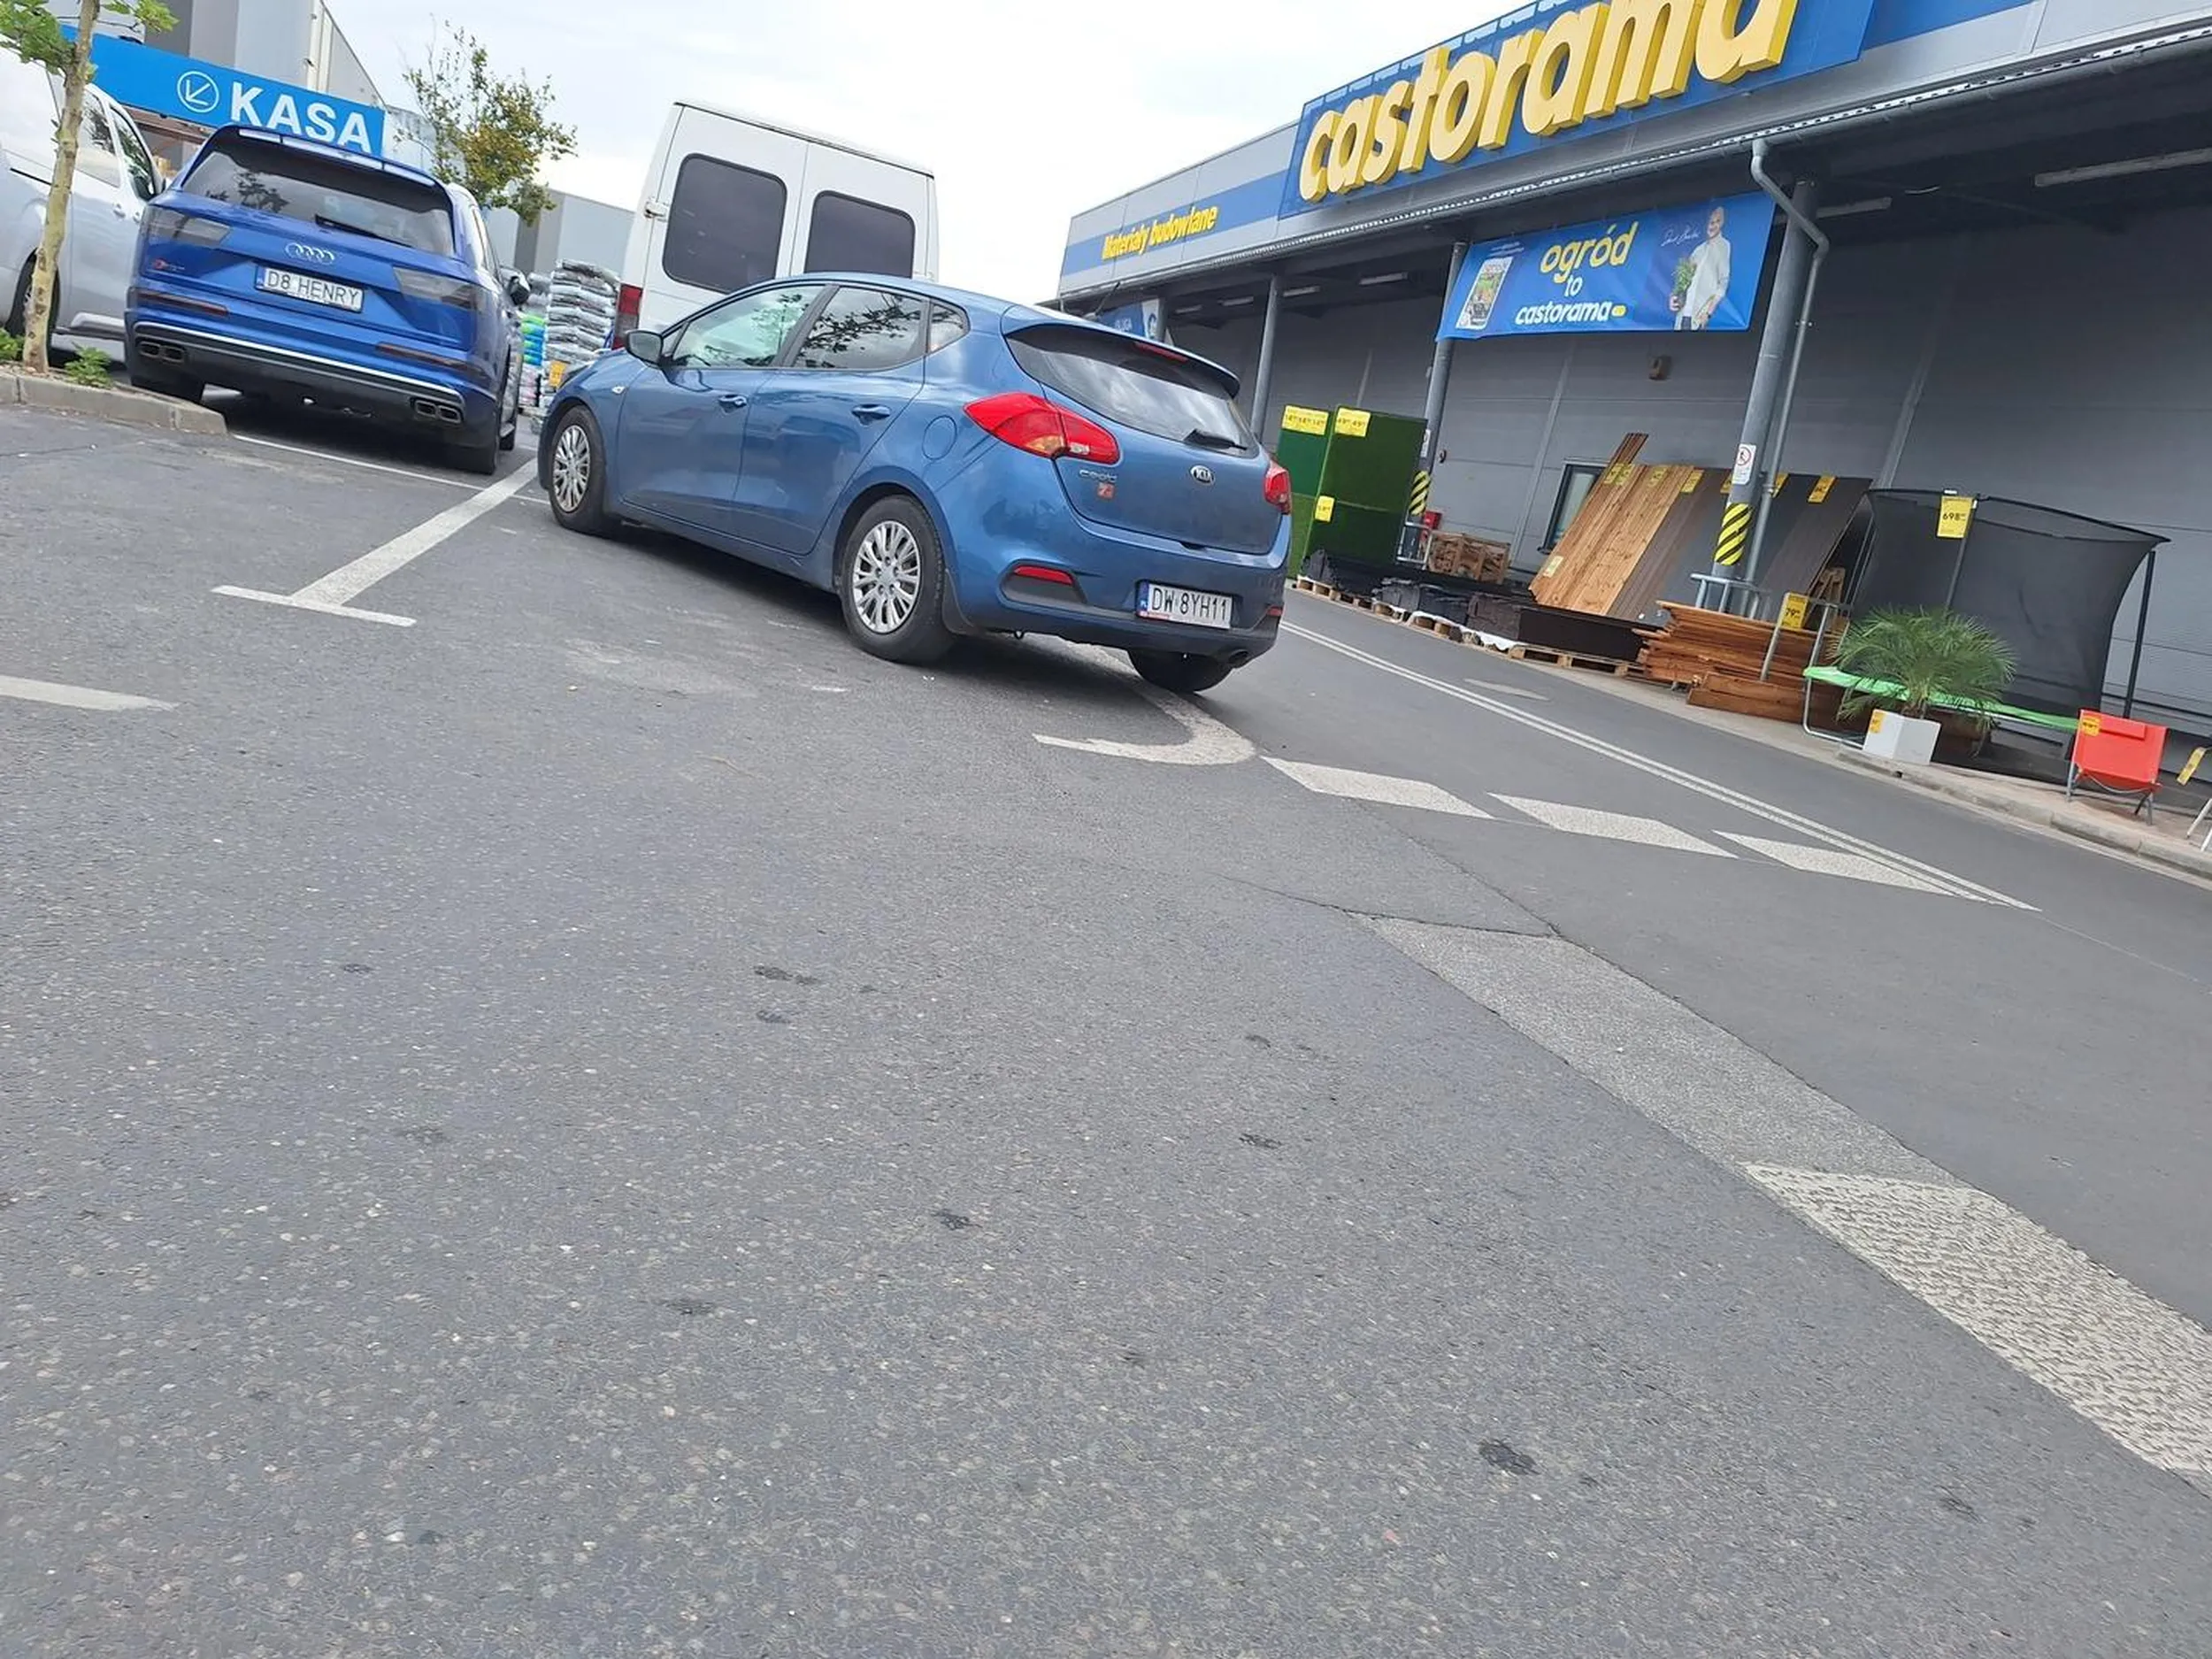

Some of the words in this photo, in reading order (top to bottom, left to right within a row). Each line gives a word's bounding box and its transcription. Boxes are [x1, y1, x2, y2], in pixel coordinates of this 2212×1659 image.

[231, 81, 372, 154] KASA
[1300, 0, 1797, 203] castorama
[1150, 205, 1218, 247] budowlane
[1540, 220, 1640, 284] ogród
[267, 270, 291, 290] D8
[297, 276, 359, 305] HENRY
[1563, 273, 1584, 297] to
[1515, 299, 1613, 326] castorama
[1151, 588, 1175, 613] DW
[1179, 592, 1227, 622] 8YH11
